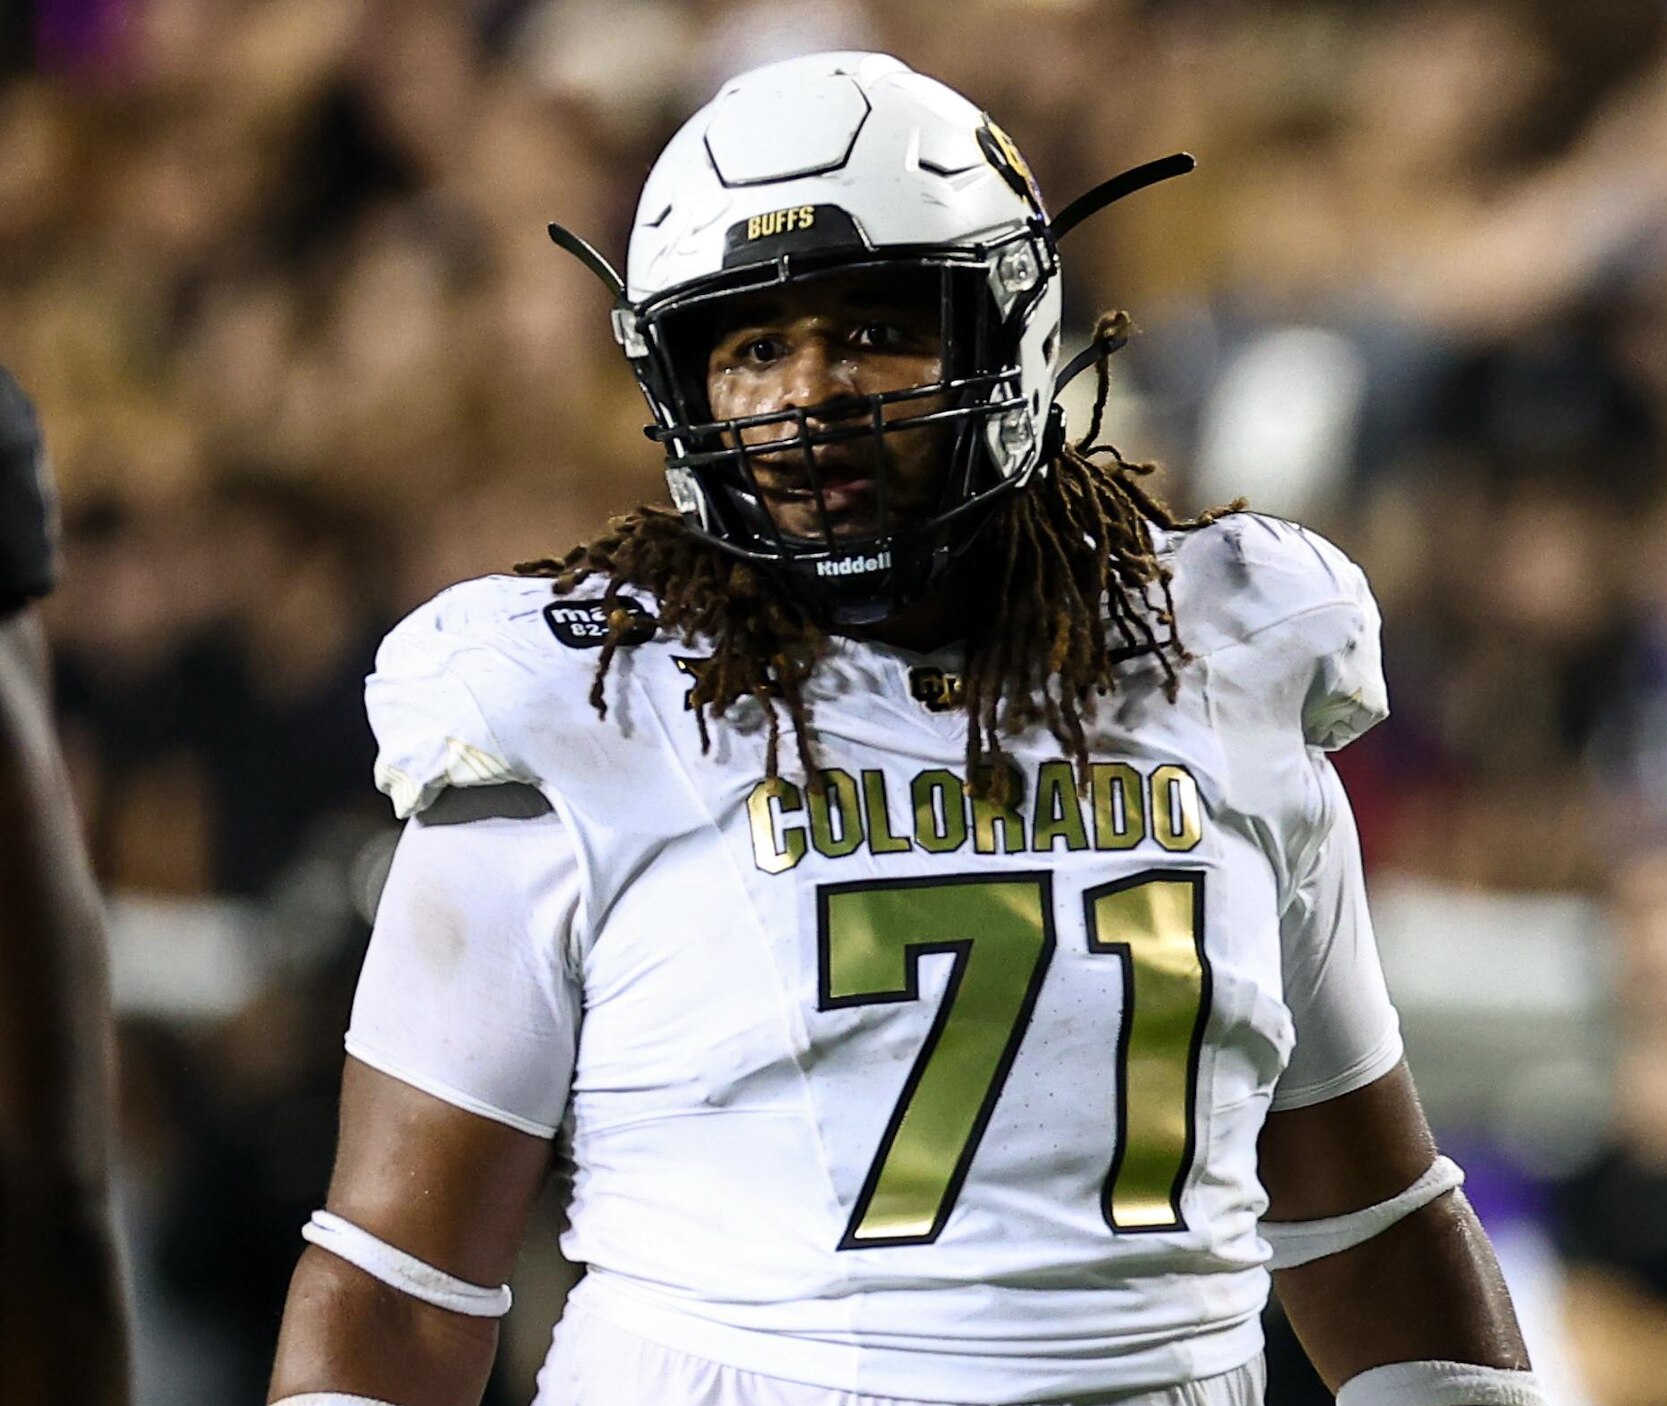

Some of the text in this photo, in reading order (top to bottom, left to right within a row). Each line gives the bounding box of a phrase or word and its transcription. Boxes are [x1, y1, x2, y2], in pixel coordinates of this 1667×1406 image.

[747, 205, 815, 241] BUFFS
[816, 551, 892, 576] Riddell
[746, 760, 1203, 875] COLORADO
[815, 869, 1213, 1251] 71
